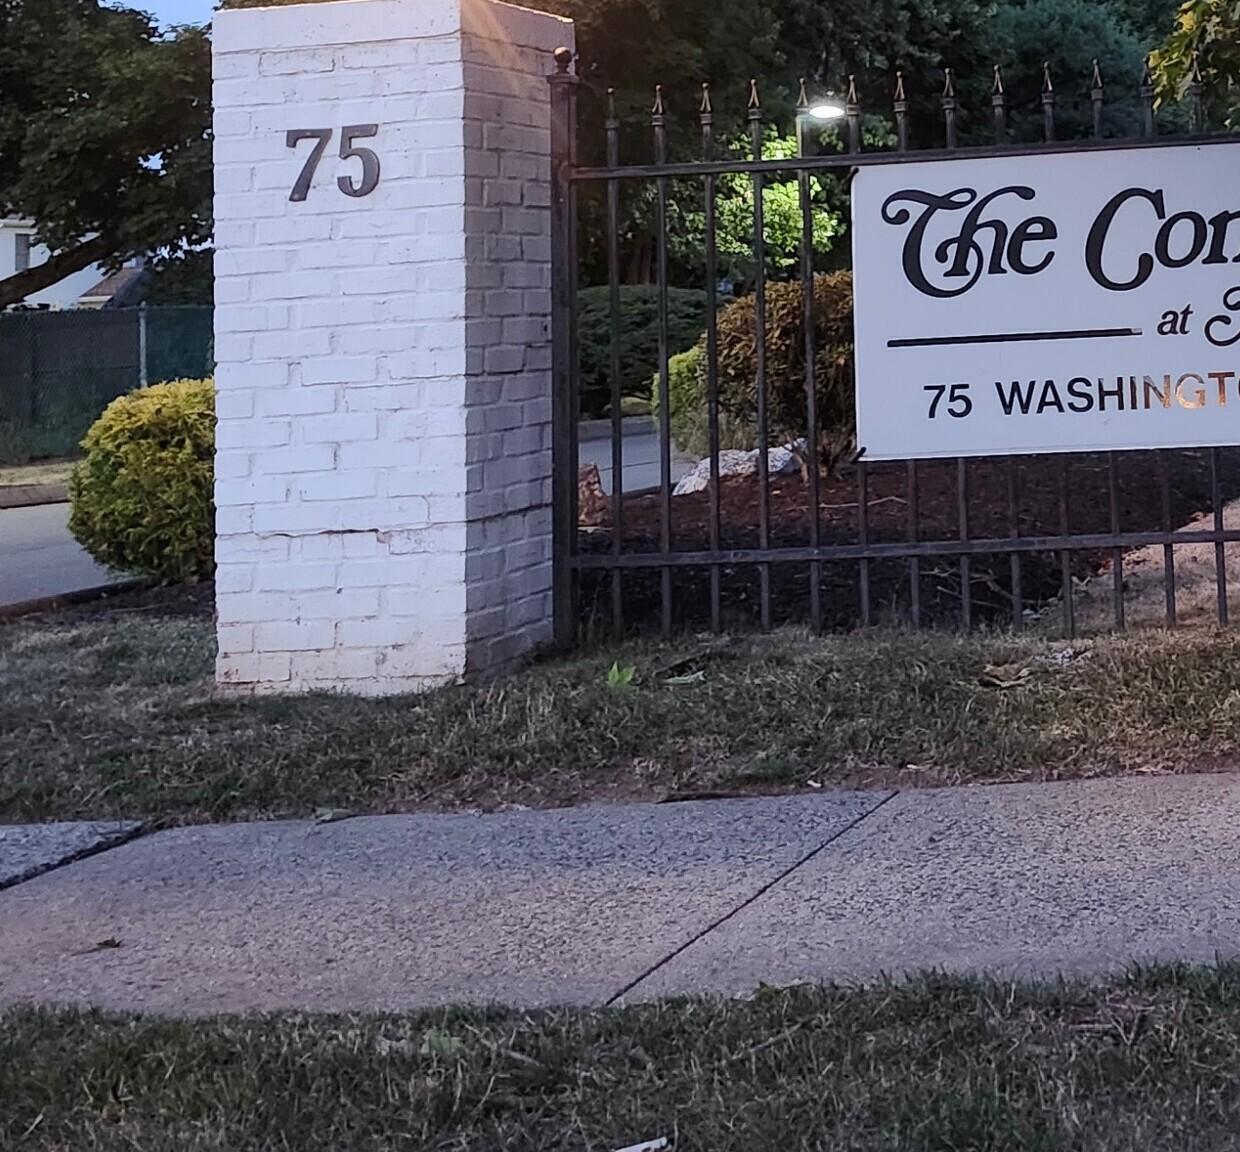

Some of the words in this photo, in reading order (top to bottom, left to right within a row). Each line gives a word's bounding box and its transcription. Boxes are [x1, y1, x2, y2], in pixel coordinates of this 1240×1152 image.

[286, 124, 381, 202] 75
[881, 186, 1058, 298] The
[1156, 304, 1195, 336] at
[923, 384, 973, 419] 75
